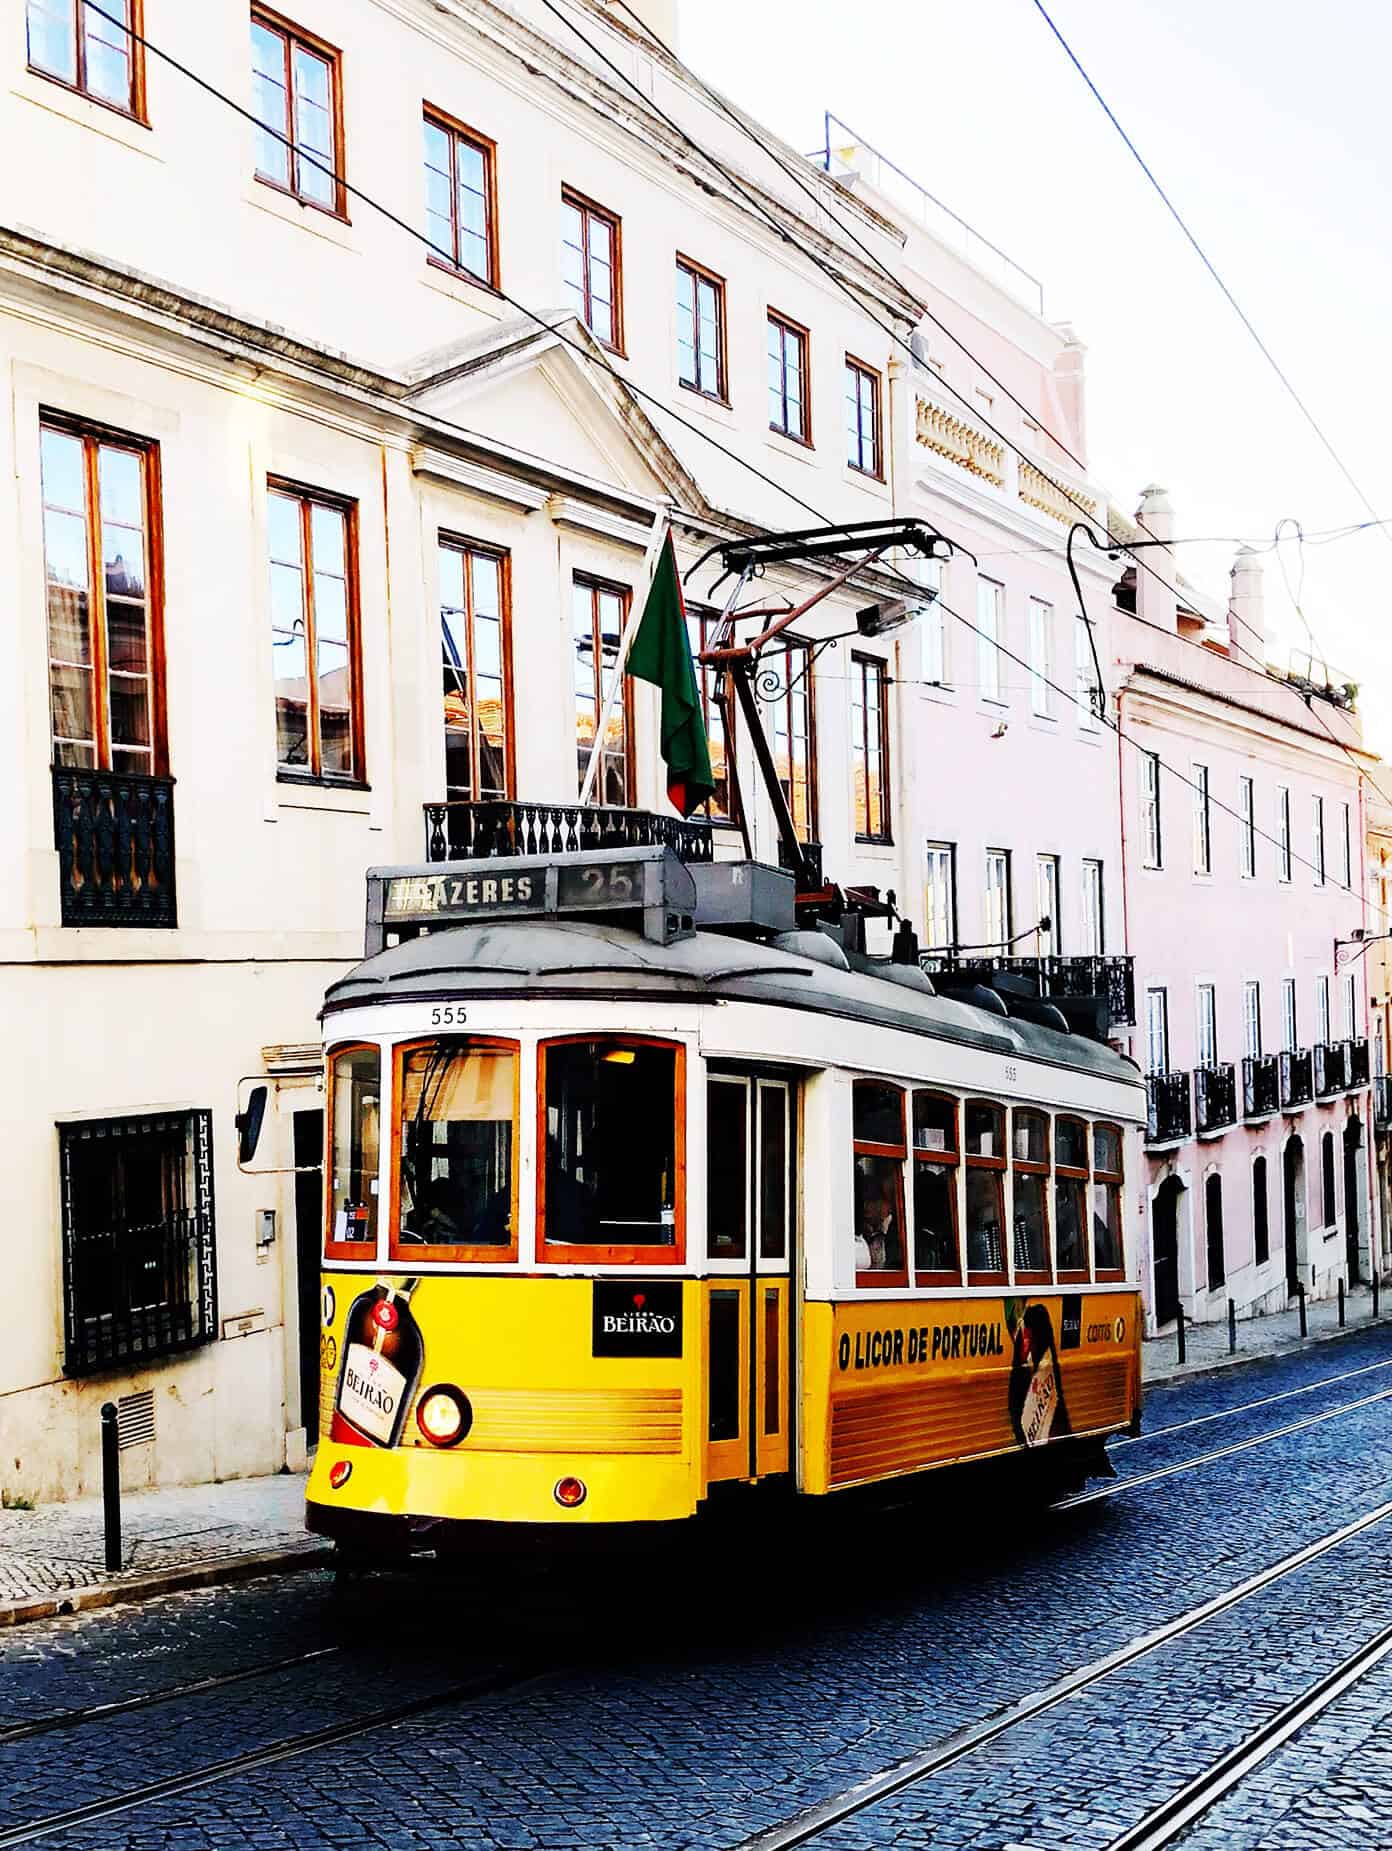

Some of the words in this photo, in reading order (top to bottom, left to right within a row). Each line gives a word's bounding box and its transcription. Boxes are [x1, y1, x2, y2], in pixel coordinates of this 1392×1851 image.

[431, 1007, 467, 1025] 555
[603, 1315, 675, 1333] BEIRÃO
[838, 1332, 850, 1371] O
[855, 1329, 903, 1369] LICOR
[908, 1327, 928, 1364] DE
[932, 1322, 1003, 1360] PORTUGAL
[346, 1367, 394, 1415] BEIRÃO
